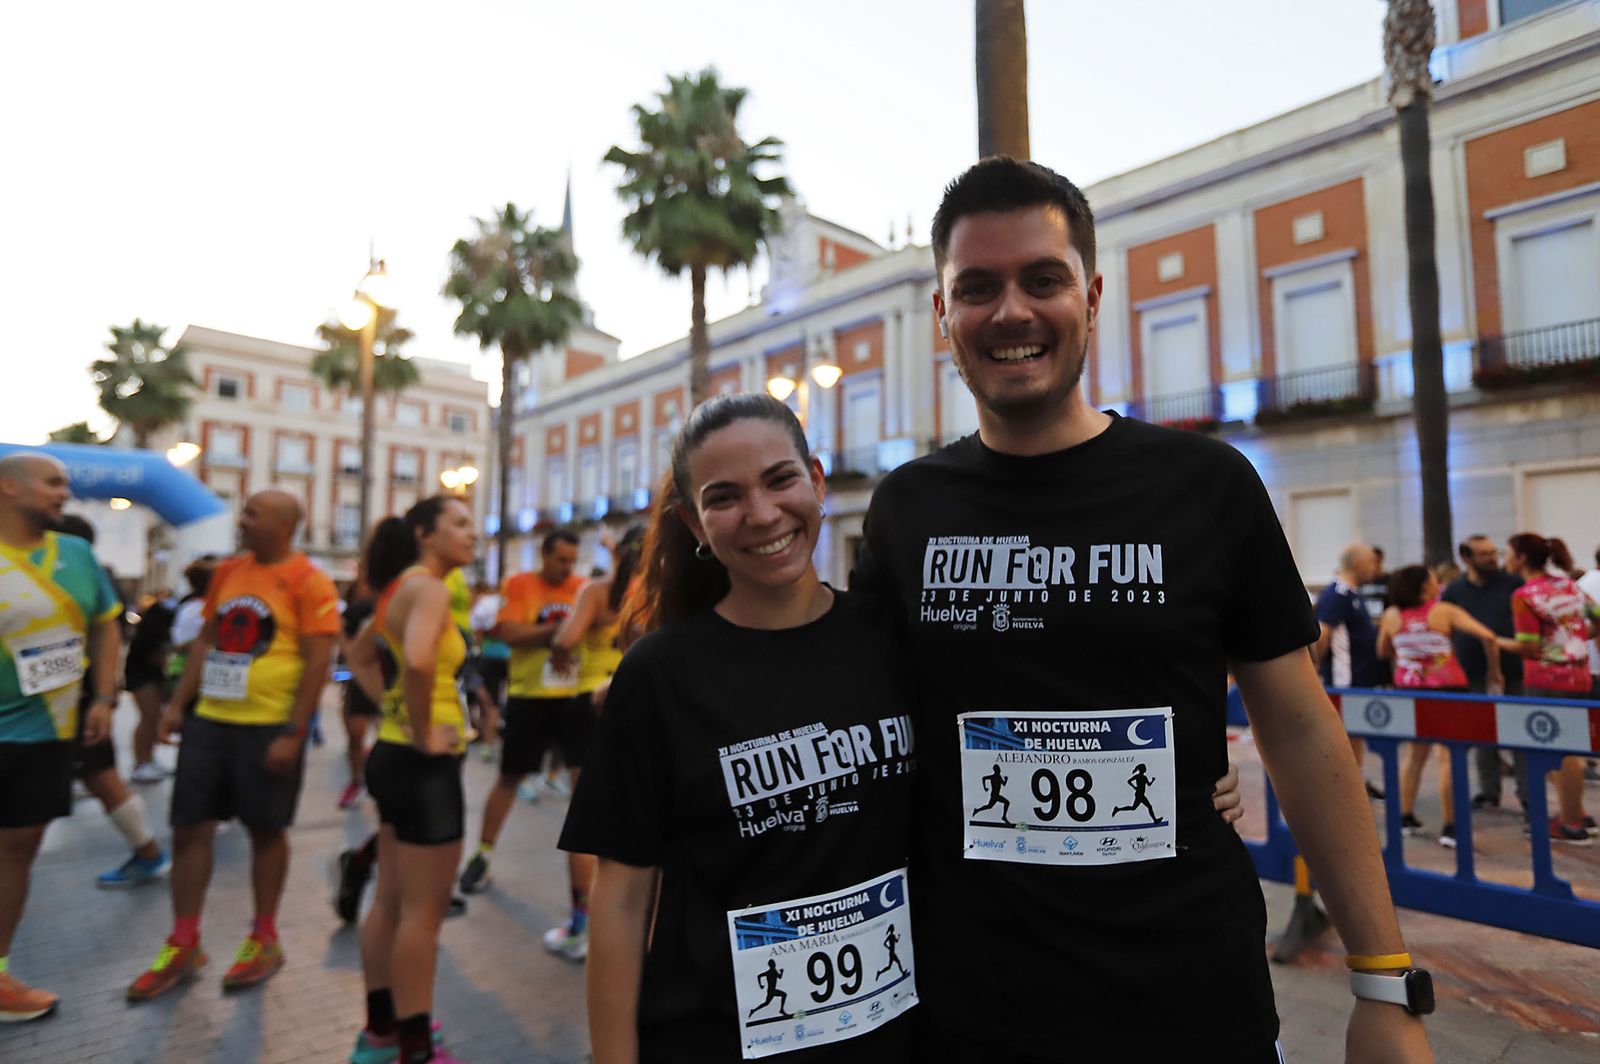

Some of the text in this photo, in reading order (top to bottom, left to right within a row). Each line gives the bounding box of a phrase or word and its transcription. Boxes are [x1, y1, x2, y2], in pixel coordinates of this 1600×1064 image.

[928, 535, 1030, 544] XI NOCTURNA DE HUELVA
[930, 544, 1163, 585] RUN FOR FUN
[921, 589, 1165, 604] 23 DE JUNIO DE 2023
[920, 604, 977, 622] Huelva
[1013, 720, 1111, 733] XI NOCTURNA
[730, 735, 778, 755] NOCTURNA
[779, 730, 792, 741] DE
[792, 722, 826, 738] HUELVA
[1024, 737, 1102, 750] DE HUELVA
[731, 744, 805, 799] RUN
[811, 725, 877, 774] FOR
[995, 752, 1071, 765] ALEJANDRO
[769, 794, 791, 809] DE
[808, 774, 859, 800] JUNIO
[1030, 768, 1096, 822] 98
[829, 805, 859, 815] HUELVA
[739, 809, 805, 838] Huelva
[972, 838, 1004, 849] Huelva
[786, 892, 870, 922] XI NOCTURNA
[797, 923, 815, 937] DE
[818, 910, 865, 933] HUELVA
[769, 940, 797, 957] ANA
[807, 944, 863, 1003] 99
